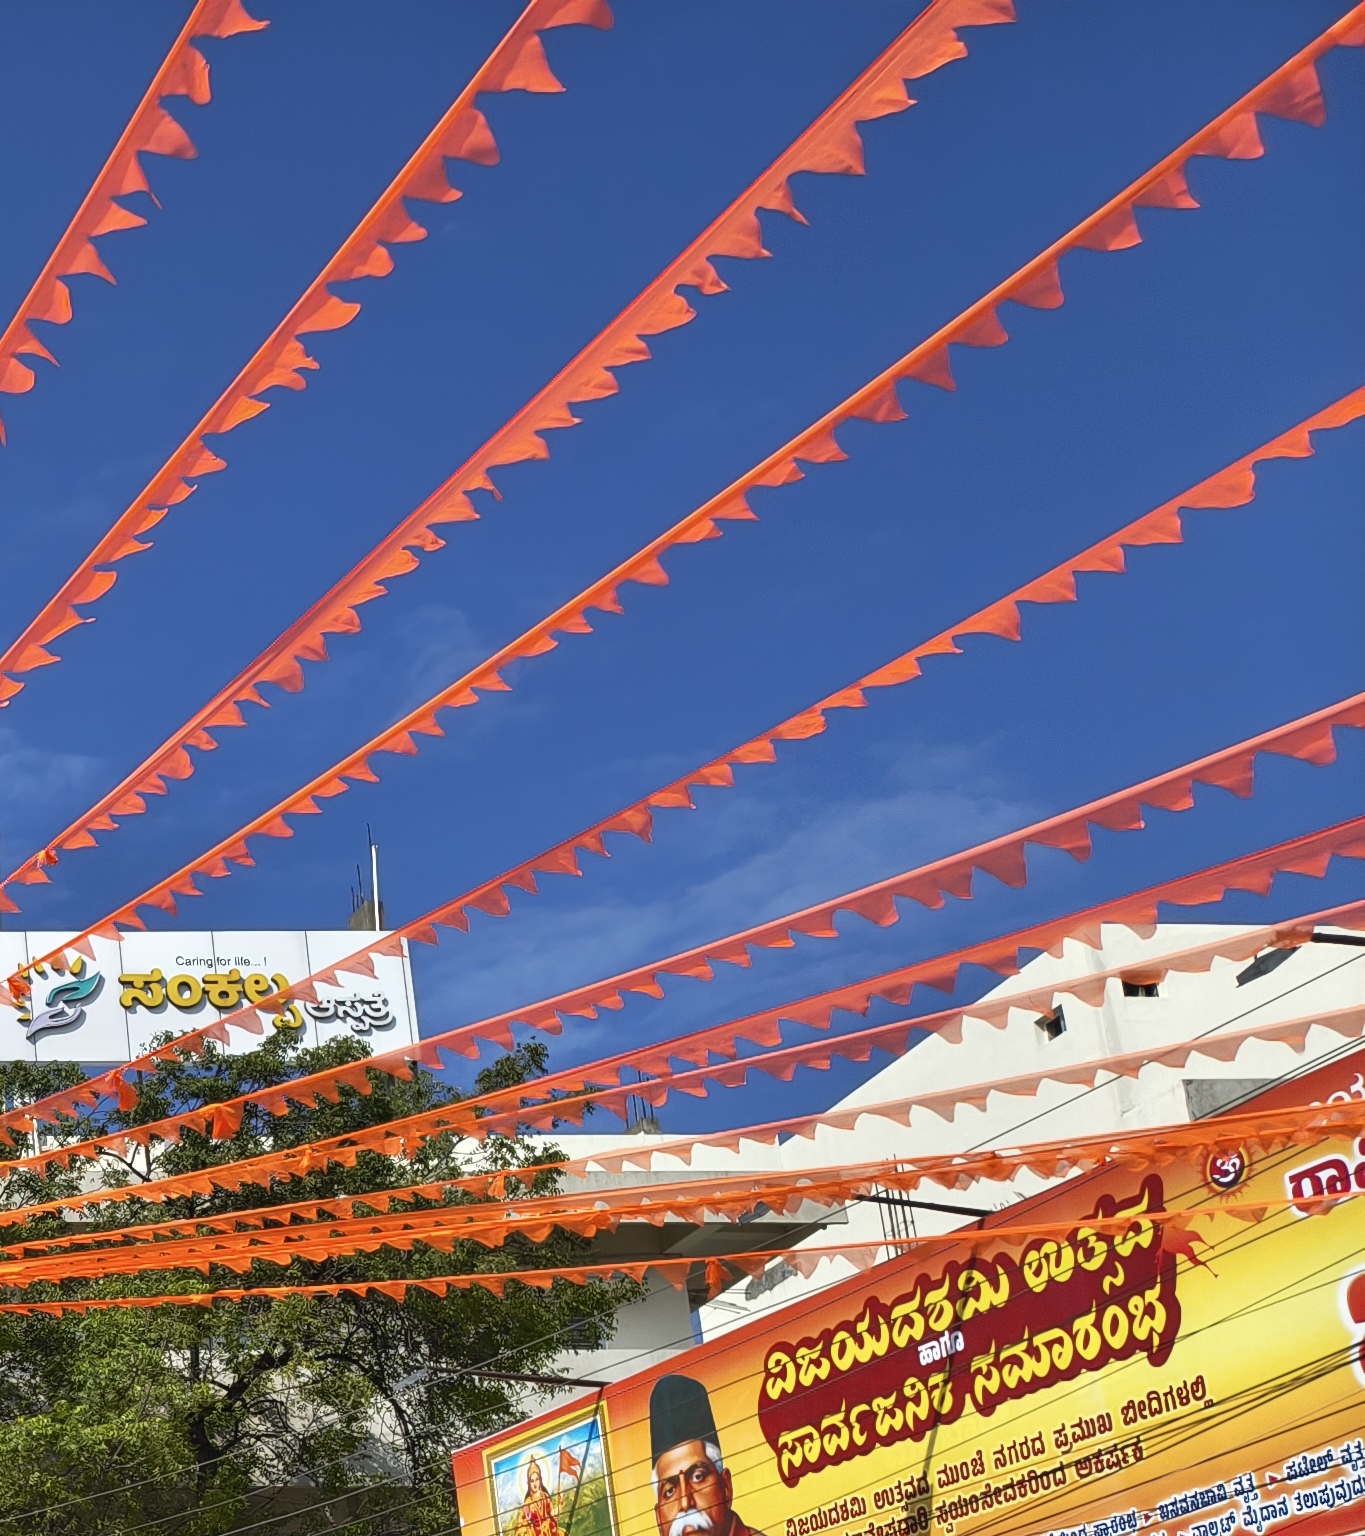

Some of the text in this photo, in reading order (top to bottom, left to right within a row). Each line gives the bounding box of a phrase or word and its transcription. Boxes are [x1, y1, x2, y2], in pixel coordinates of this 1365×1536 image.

[118, 967, 393, 1030] ಸಂಕಲ್ಪ ಆಸ್ಪತ್ರೆ
[176, 956, 231, 969] Caring for
[765, 1187, 1155, 1399] ವಿಜಯದಶಮಿ ಉತ್ಸವ
[778, 1275, 1167, 1474] ಸಾರ್ವಜನಿಕ ಸಮಾರಂಭ
[918, 1328, 965, 1366] ಹಾಗೂ
[874, 1470, 929, 1516] ಉತ್ಸವದ
[937, 1450, 985, 1489] ಮುಂಚೆ
[992, 1433, 1045, 1471] ನಗರದ
[1054, 1409, 1113, 1453] ಪ್ರಮುಖ
[1121, 1374, 1215, 1425] ಬೀದಿಗಳಲ್ಲಿ
